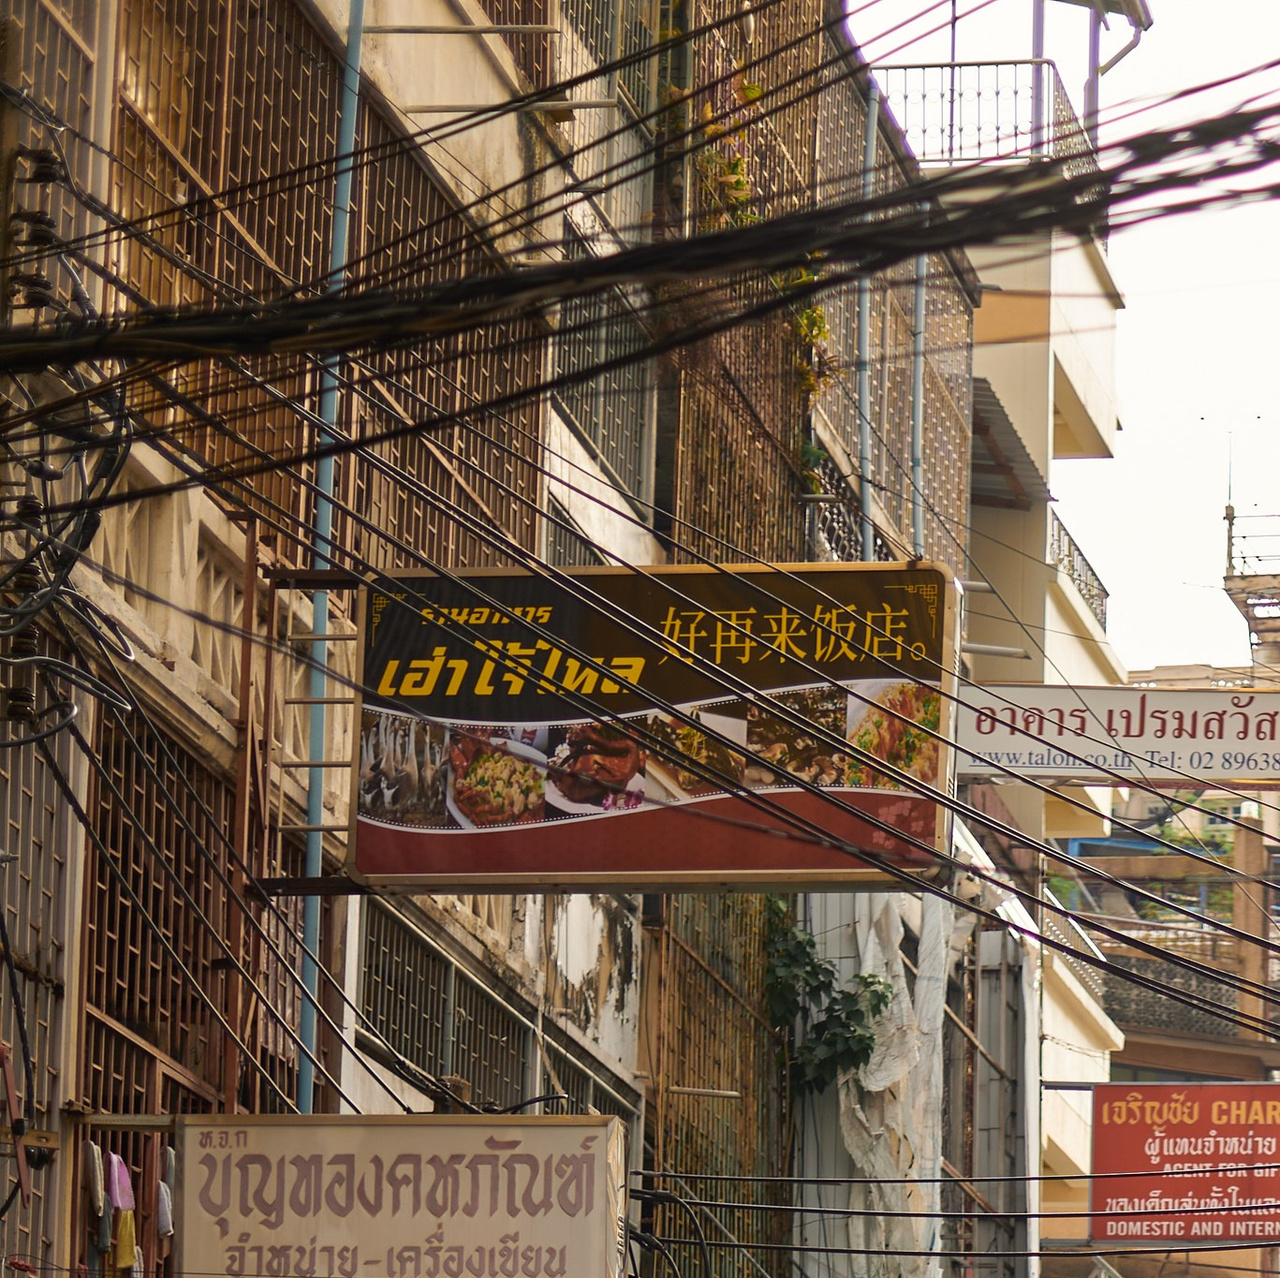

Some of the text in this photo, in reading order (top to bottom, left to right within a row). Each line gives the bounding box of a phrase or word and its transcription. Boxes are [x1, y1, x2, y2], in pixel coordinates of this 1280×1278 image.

[974, 705, 1087, 738] อาคาร
[1145, 750, 1182, 770] Tel:
[1189, 751, 1215, 771] 02
[1102, 1091, 1200, 1126] เจริญชัย
[1144, 1125, 1277, 1164] ผู้แทนจำหน่าย
[1162, 1163, 1213, 1178] AGENT
[1217, 1163, 1248, 1178] FOR
[1107, 1221, 1185, 1236] DOMESTIC
[1191, 1221, 1224, 1236] AND
